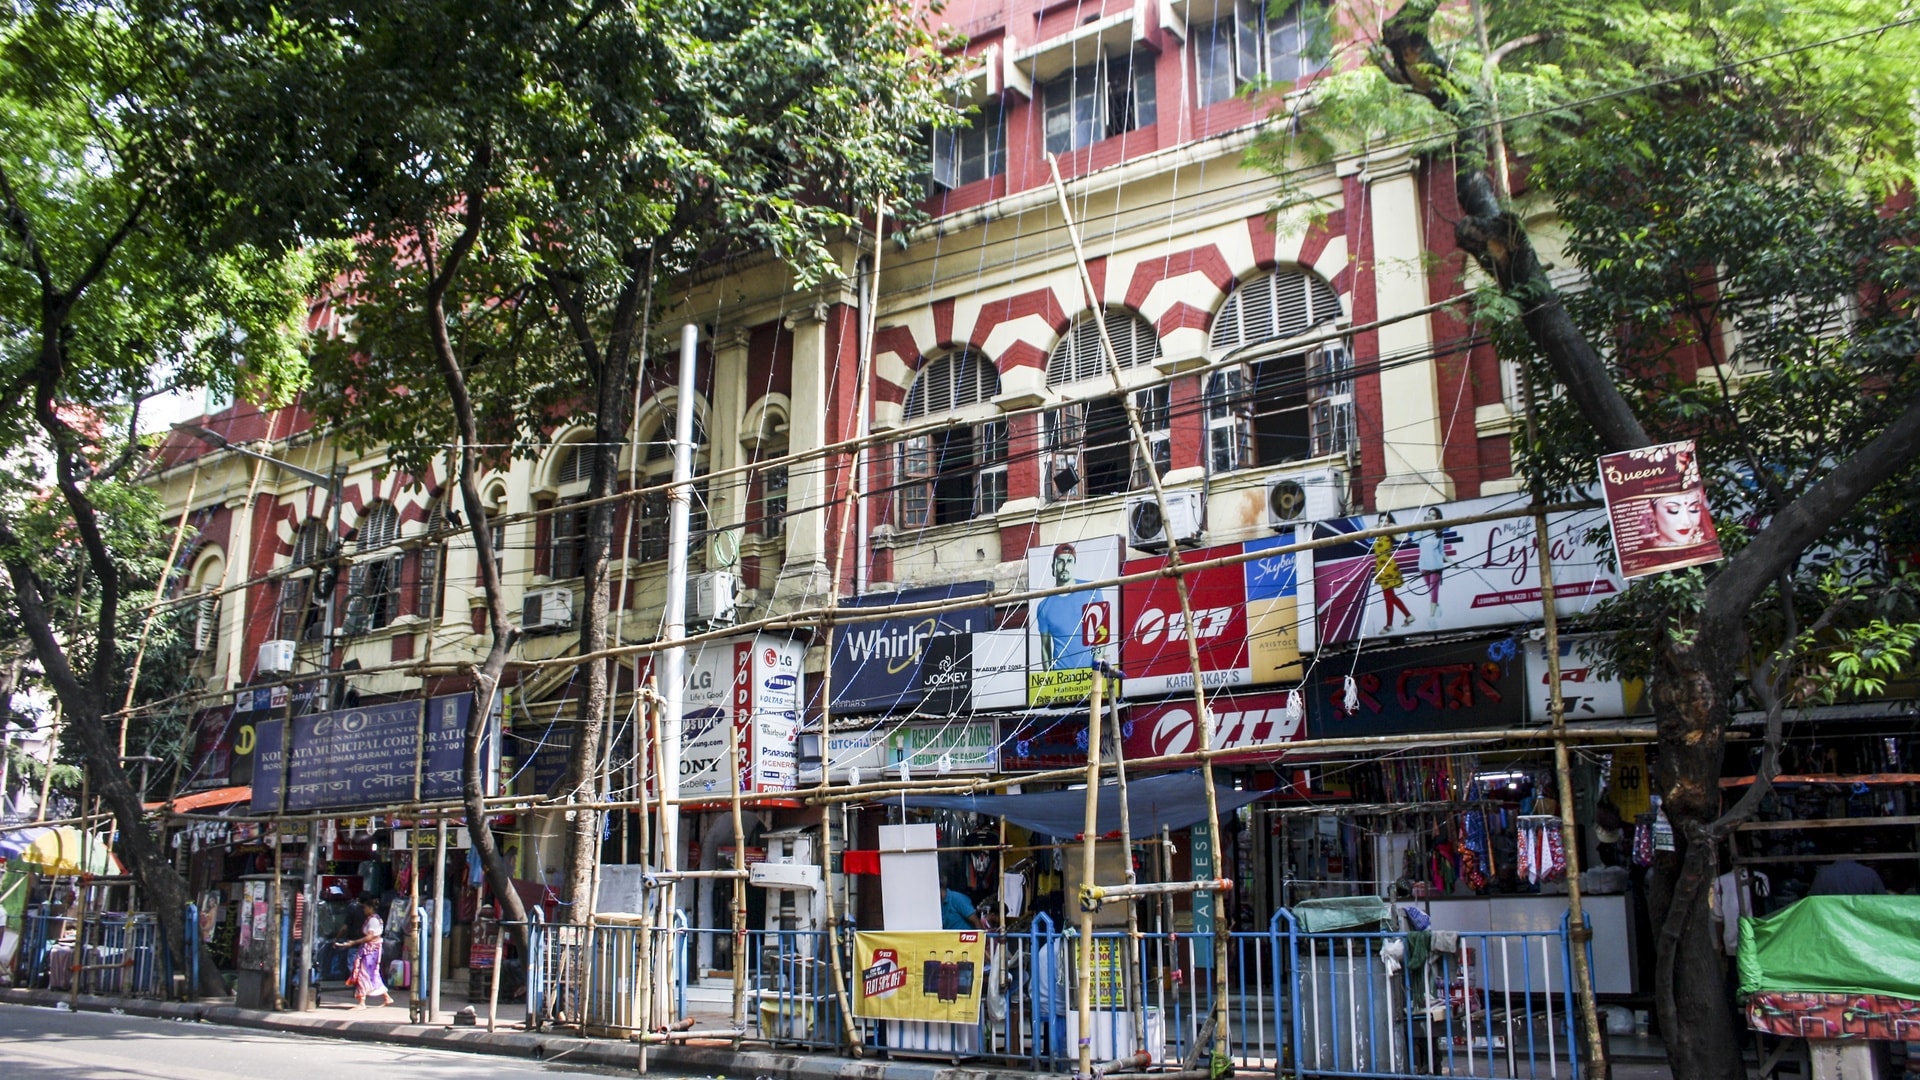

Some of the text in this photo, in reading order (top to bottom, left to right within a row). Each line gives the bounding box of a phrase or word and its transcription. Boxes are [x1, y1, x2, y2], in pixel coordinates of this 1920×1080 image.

[1607, 466, 1666, 485] Queen
[1483, 526, 1576, 586] Lyra
[847, 618, 971, 665] Whirlp
[690, 671, 712, 690] LG
[923, 670, 968, 686] JOCKEY
[1031, 673, 1055, 687] New
[314, 737, 381, 756] MUNICIPAL
[911, 727, 940, 750] READY
[941, 726, 966, 749] MADE
[967, 724, 993, 748] ZONE
[680, 757, 722, 776] ONY
[767, 760, 797, 769] GENERA
[865, 978, 879, 996] FLAT
